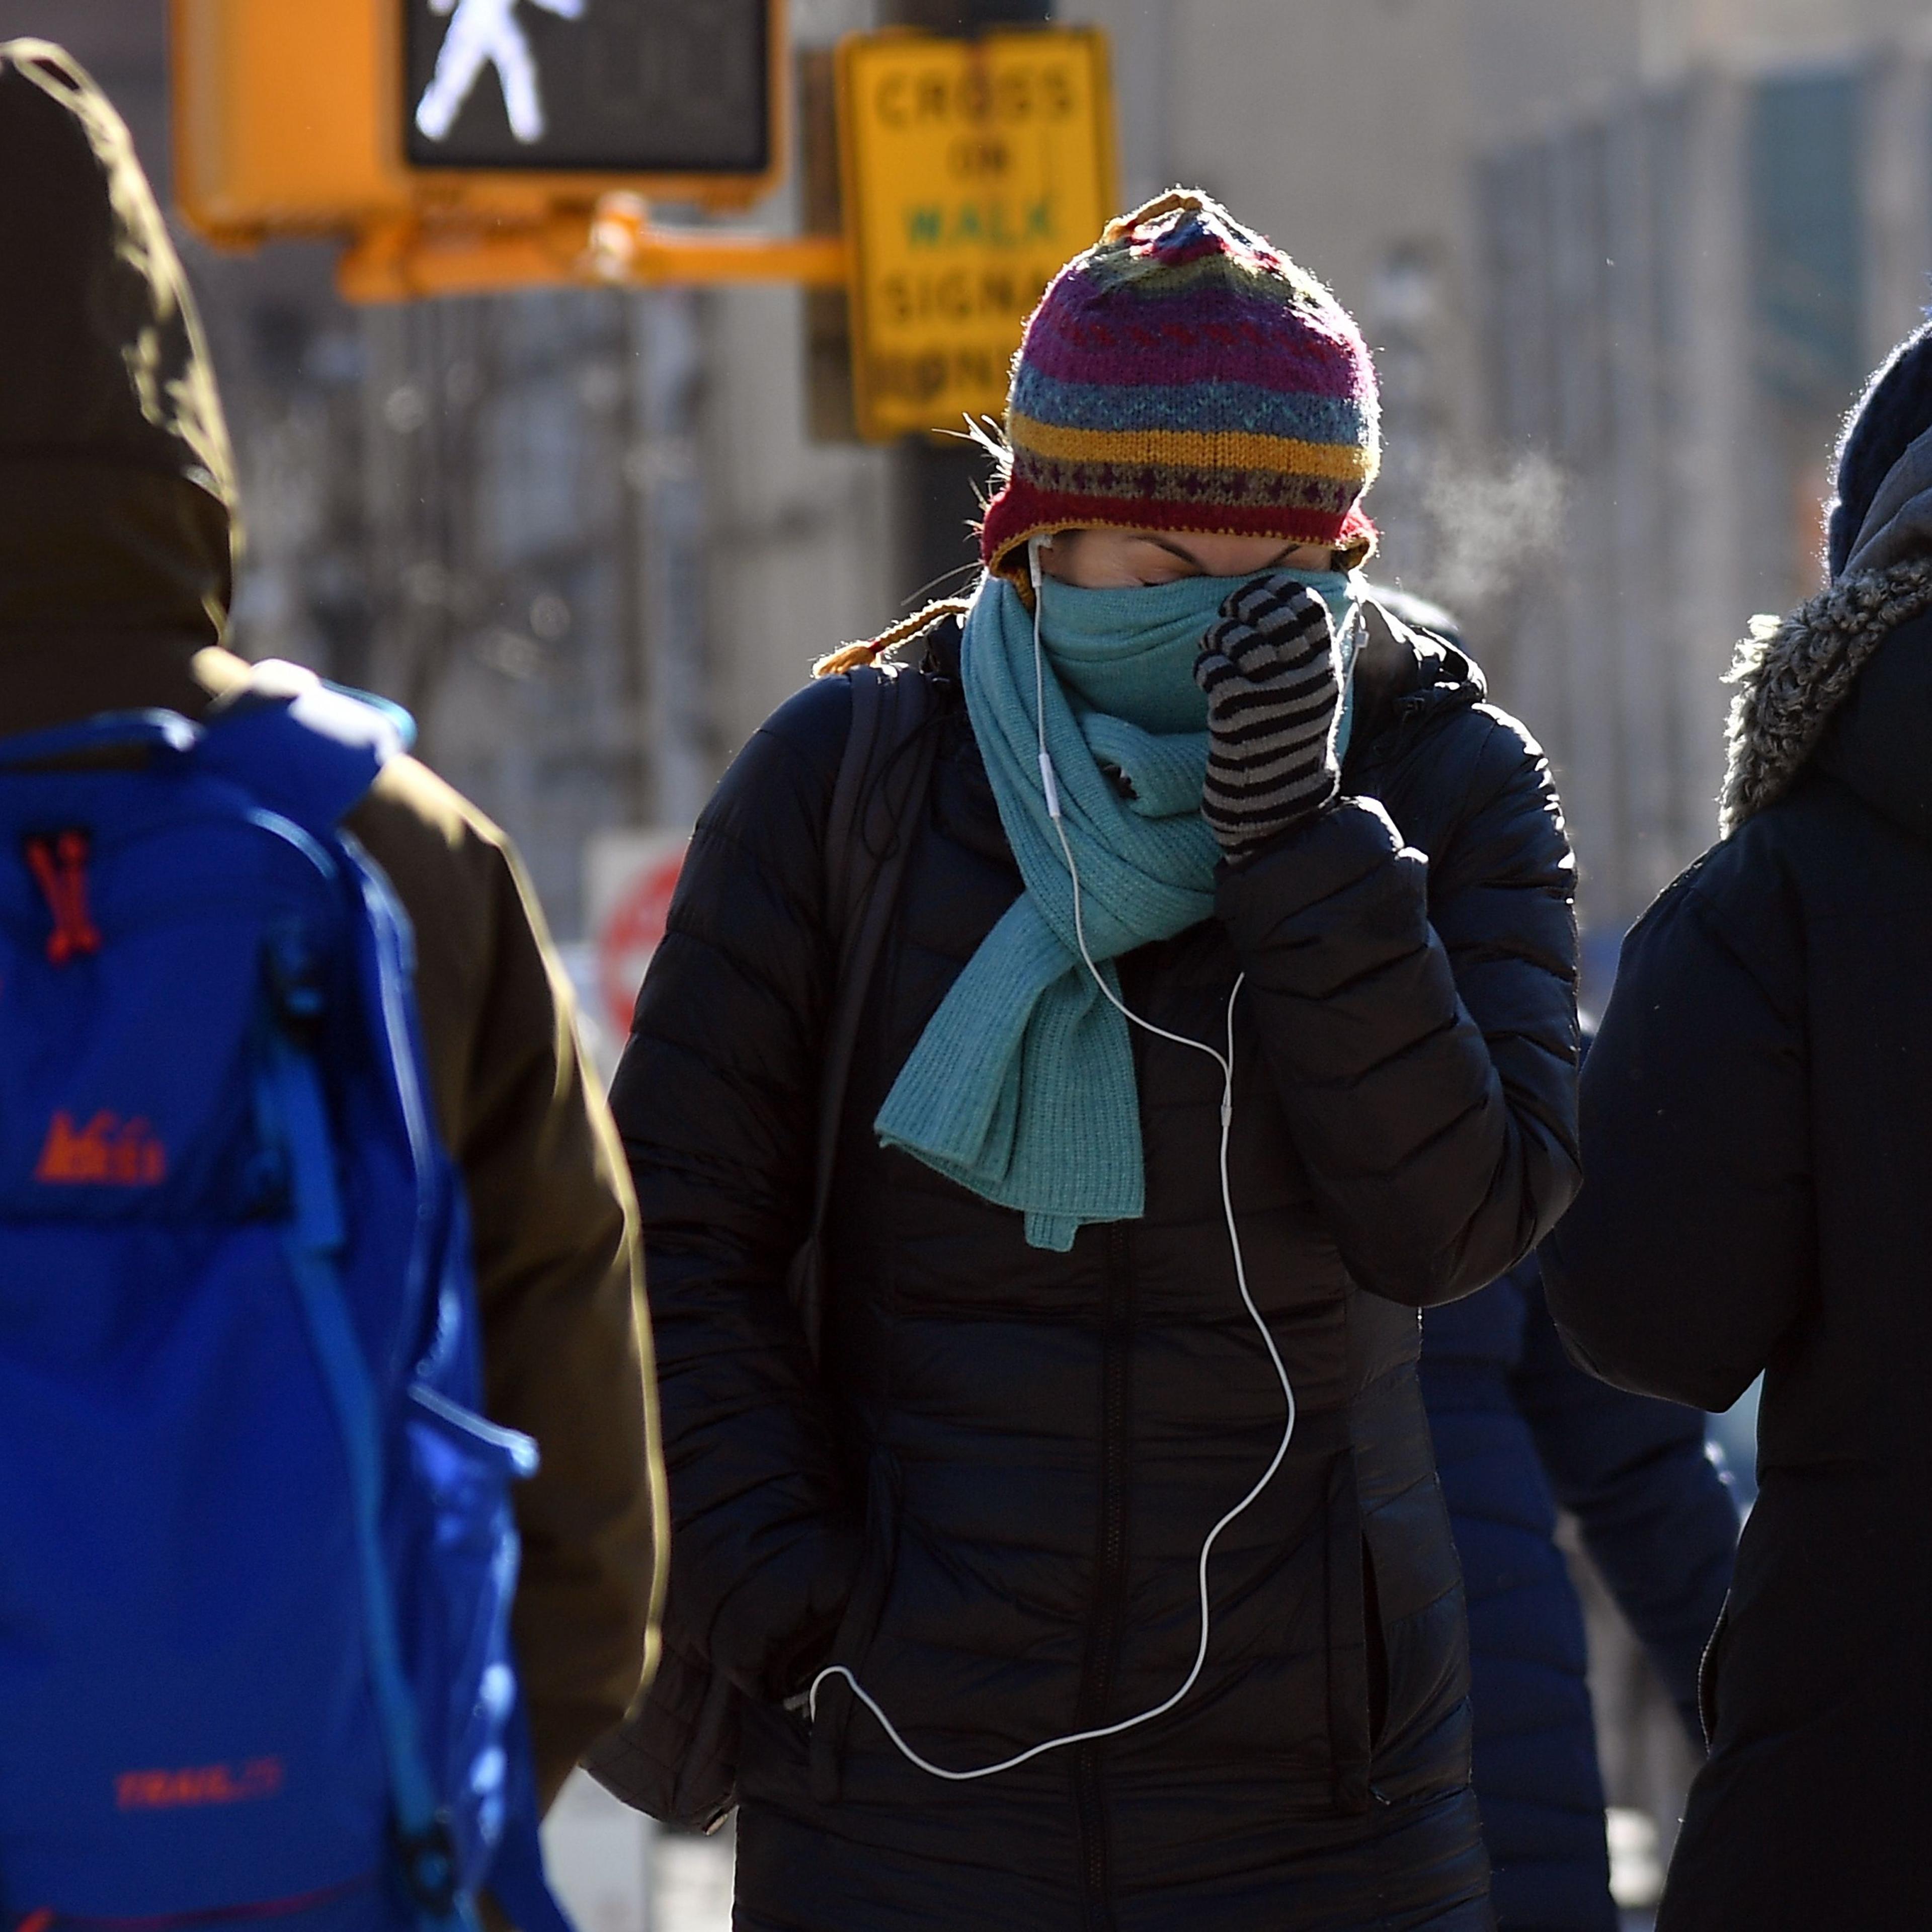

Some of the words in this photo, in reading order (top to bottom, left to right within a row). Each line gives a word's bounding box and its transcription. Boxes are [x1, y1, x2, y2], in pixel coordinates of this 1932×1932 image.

[875, 65, 1073, 132] CROSS
[906, 199, 1053, 247] WALK
[881, 267, 1051, 327] SIGN
